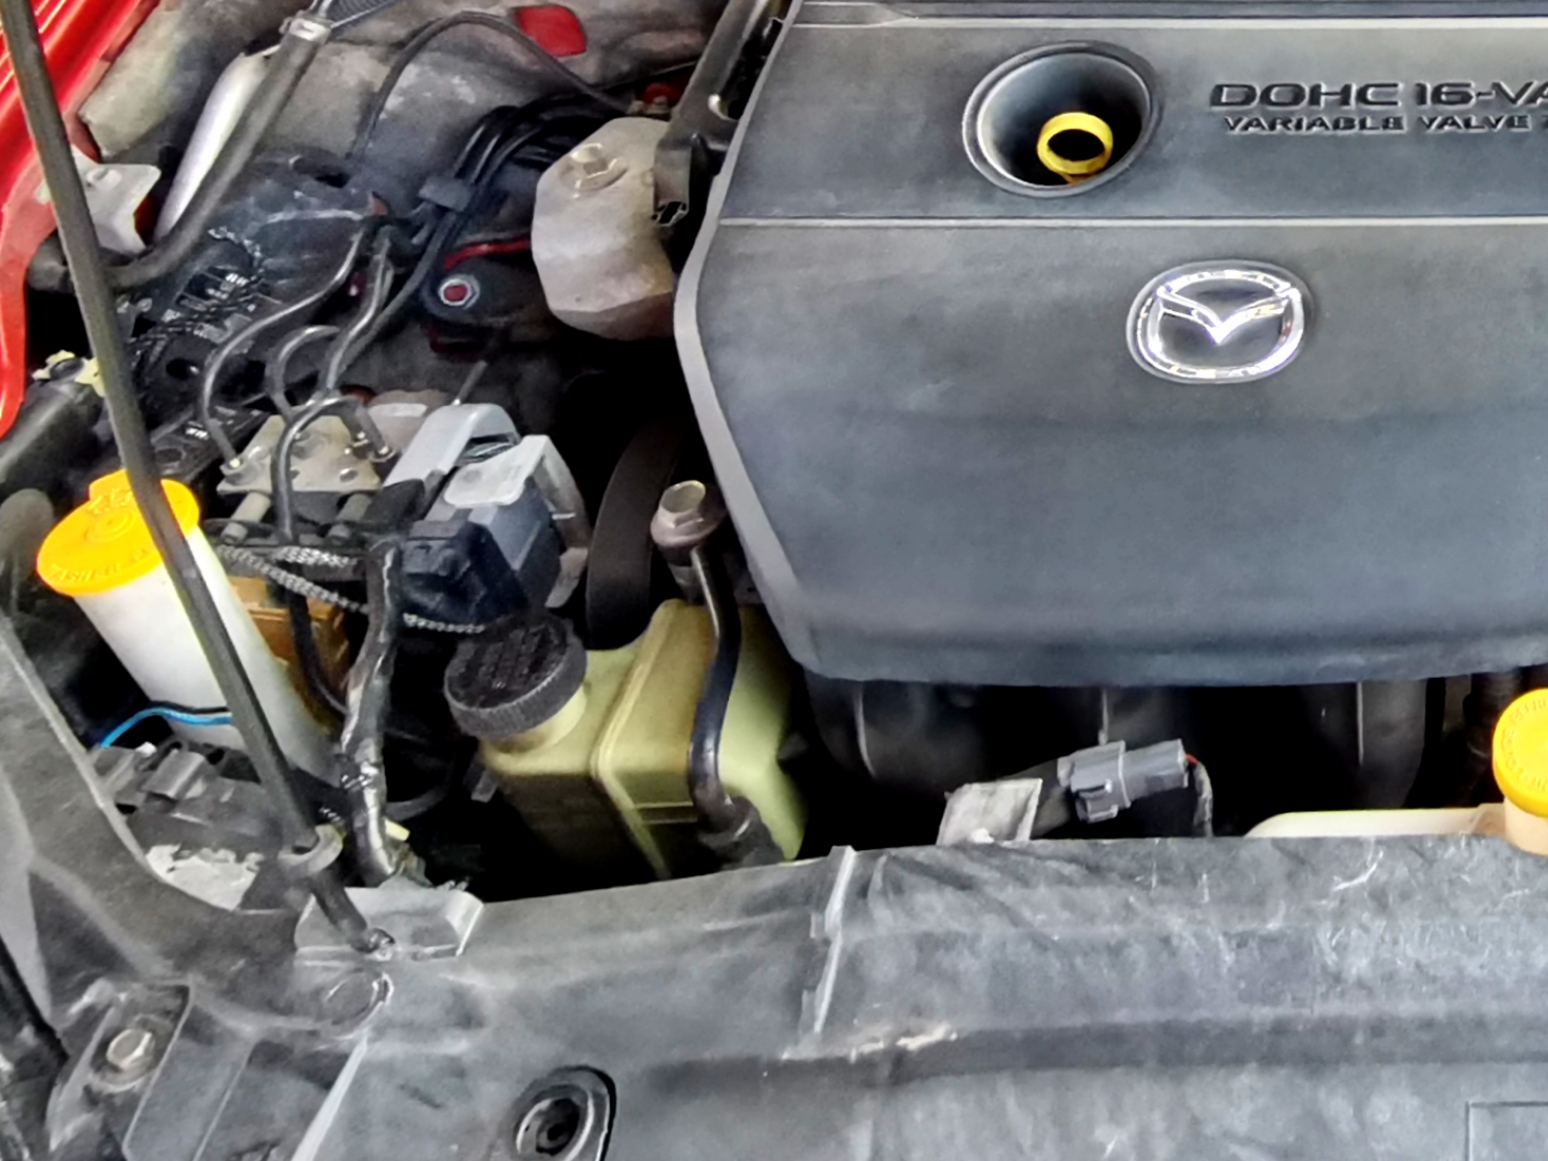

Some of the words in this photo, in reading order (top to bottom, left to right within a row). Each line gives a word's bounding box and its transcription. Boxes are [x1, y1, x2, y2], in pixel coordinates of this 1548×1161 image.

[1209, 81, 1404, 109] DOHC
[1222, 115, 1408, 134] VARIABLE
[1416, 113, 1532, 132] VALVE
